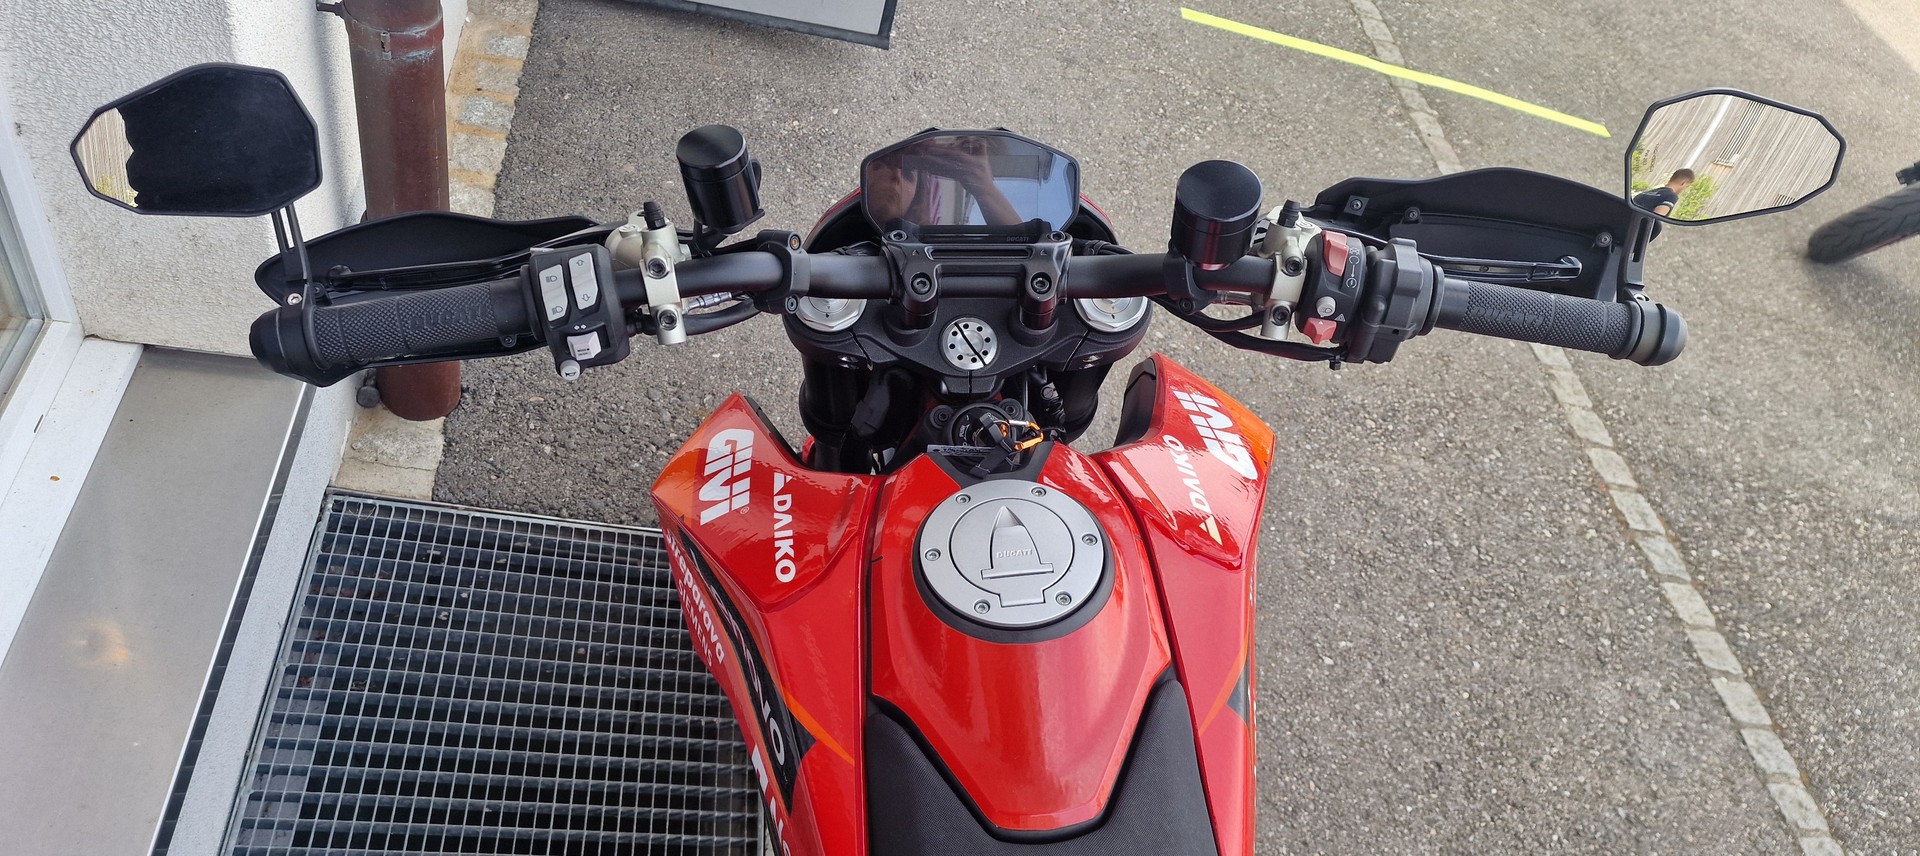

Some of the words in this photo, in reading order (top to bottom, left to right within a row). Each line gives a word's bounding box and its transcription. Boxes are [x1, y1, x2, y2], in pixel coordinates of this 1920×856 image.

[409, 306, 487, 332] DUCATI
[1471, 305, 1544, 327] DUCATI
[699, 429, 755, 527] GIVI
[1162, 434, 1213, 515] DAIKO
[1173, 390, 1258, 481] GIVI
[773, 493, 797, 583] DAIKO
[996, 548, 1033, 560] DUCATI
[677, 578, 714, 668] SIEMENS
